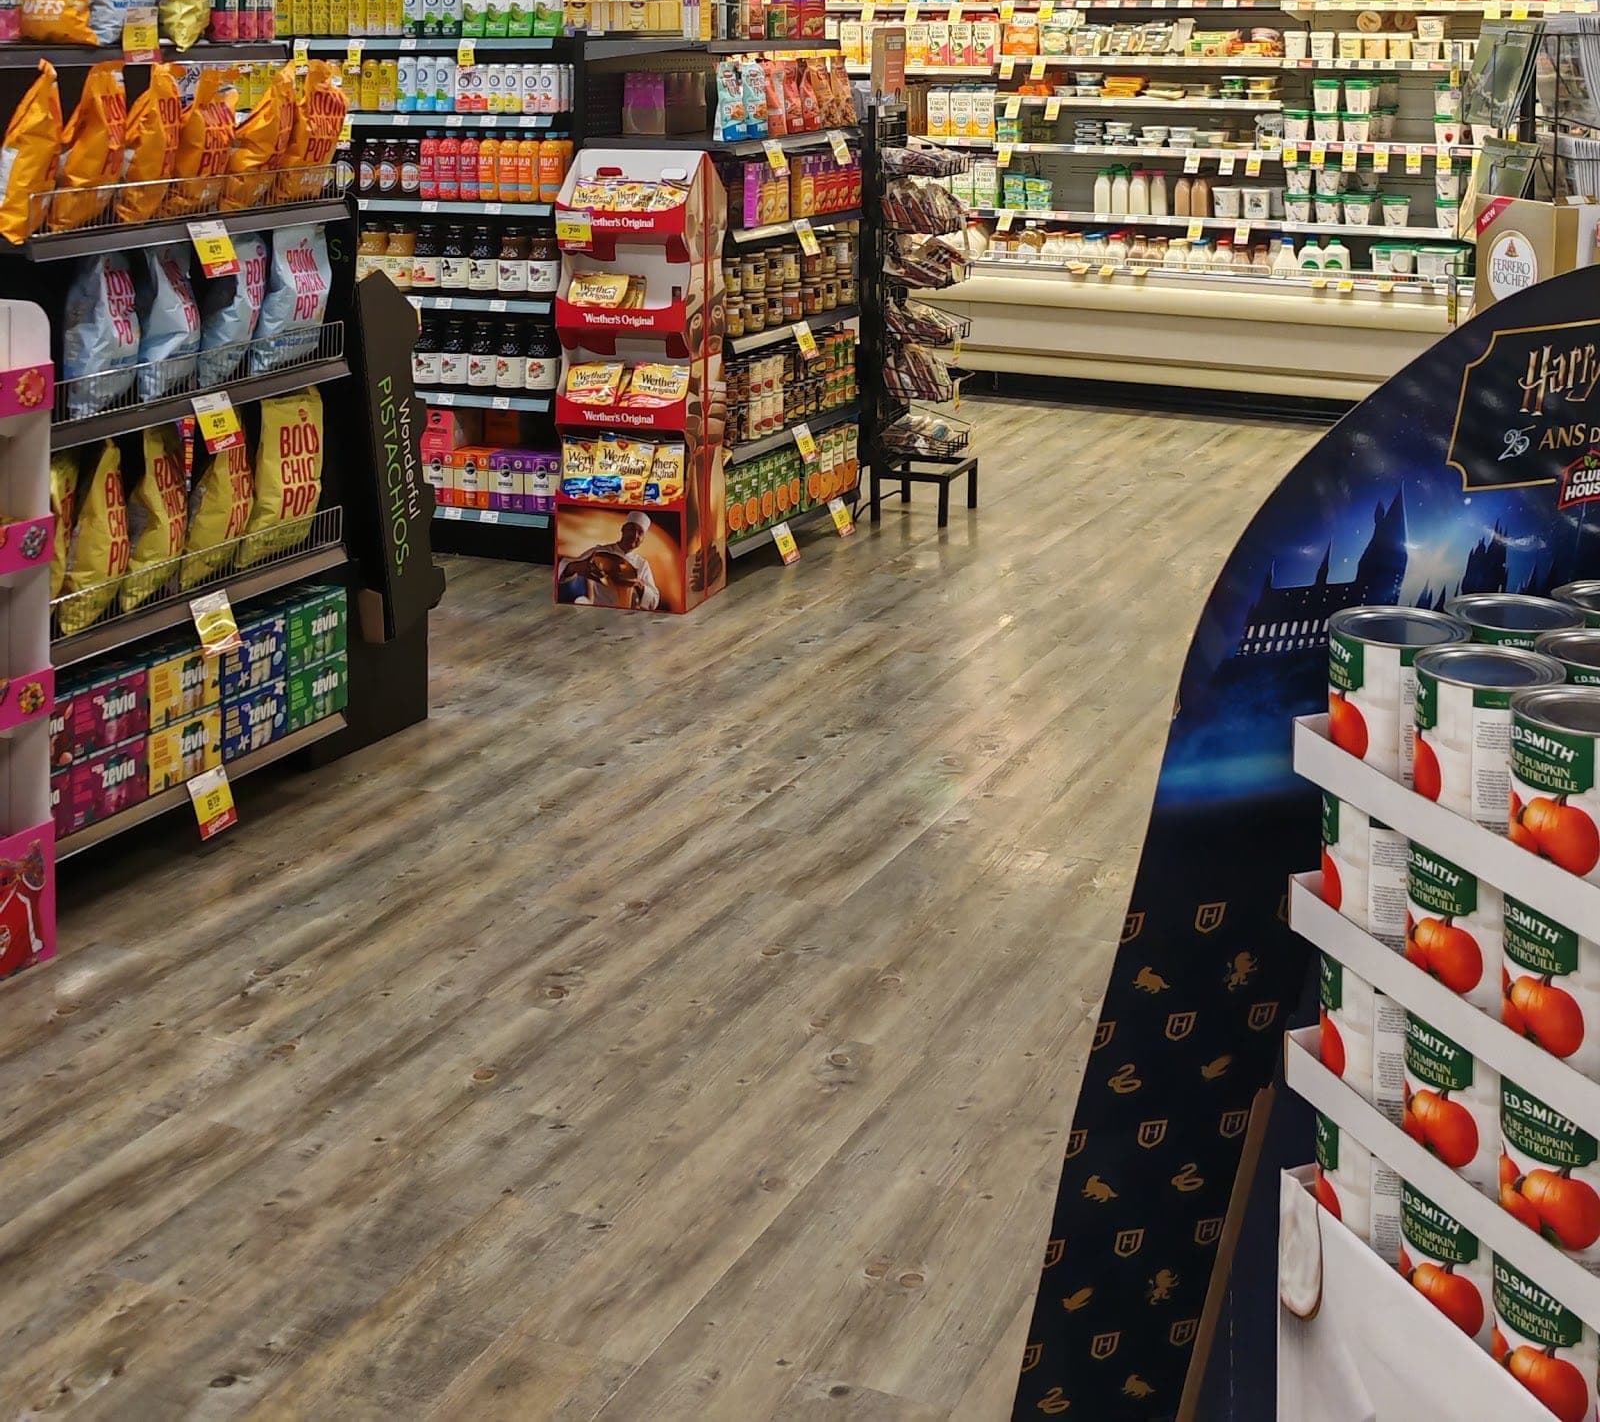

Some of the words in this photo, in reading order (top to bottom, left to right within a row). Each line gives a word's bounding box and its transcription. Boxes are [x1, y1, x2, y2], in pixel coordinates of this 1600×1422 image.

[1011, 15, 1034, 26] Daiya
[308, 116, 345, 138] CHICK
[303, 137, 332, 163] POP
[621, 217, 654, 230] Original
[1480, 206, 1497, 227] NEW
[1492, 257, 1531, 276] FERRERO
[1492, 271, 1531, 288] ROCHER
[293, 293, 320, 322] POP
[582, 312, 621, 325] Werther's
[621, 314, 655, 327] Original
[1518, 343, 1600, 417] Harry
[582, 410, 621, 423] Werther's
[621, 412, 654, 426] Original
[1498, 425, 1537, 461] 25
[1538, 423, 1587, 452] ANS
[398, 396, 421, 521] Wonderful
[568, 448, 595, 465] Werth
[652, 455, 679, 470] ther's
[280, 456, 316, 486] CHIC
[377, 374, 411, 568] PISTACHIOS
[652, 465, 677, 482] riginal
[279, 483, 317, 520] POP
[1565, 481, 1600, 502] HOUS
[107, 540, 130, 577] PO
[311, 609, 339, 635] zevia
[248, 634, 277, 663] zevia
[312, 671, 339, 698] zevia
[102, 690, 137, 720] zevia
[248, 697, 277, 726] zevia
[102, 758, 136, 789] zevia
[1520, 765, 1579, 792] CITROUILLE
[1524, 756, 1570, 779] PUMPKIN
[1412, 886, 1462, 915] CITROUILLE
[1415, 877, 1456, 902] PUMPKIN
[1508, 941, 1563, 974] CITROUILLE
[1512, 932, 1555, 960] PUMPKIN
[1409, 1056, 1460, 1089] CITROUILLE
[1412, 1048, 1452, 1076] PUMPKIN
[1518, 1134, 1582, 1165] CITROUILLE
[1523, 1126, 1574, 1153] PUMPKIN
[1409, 1229, 1464, 1262] CITROUILLE
[1414, 1221, 1457, 1251] PUMPKIN
[1506, 1309, 1567, 1346] CITROUILLE
[1511, 1301, 1559, 1332] PUMPKIN
